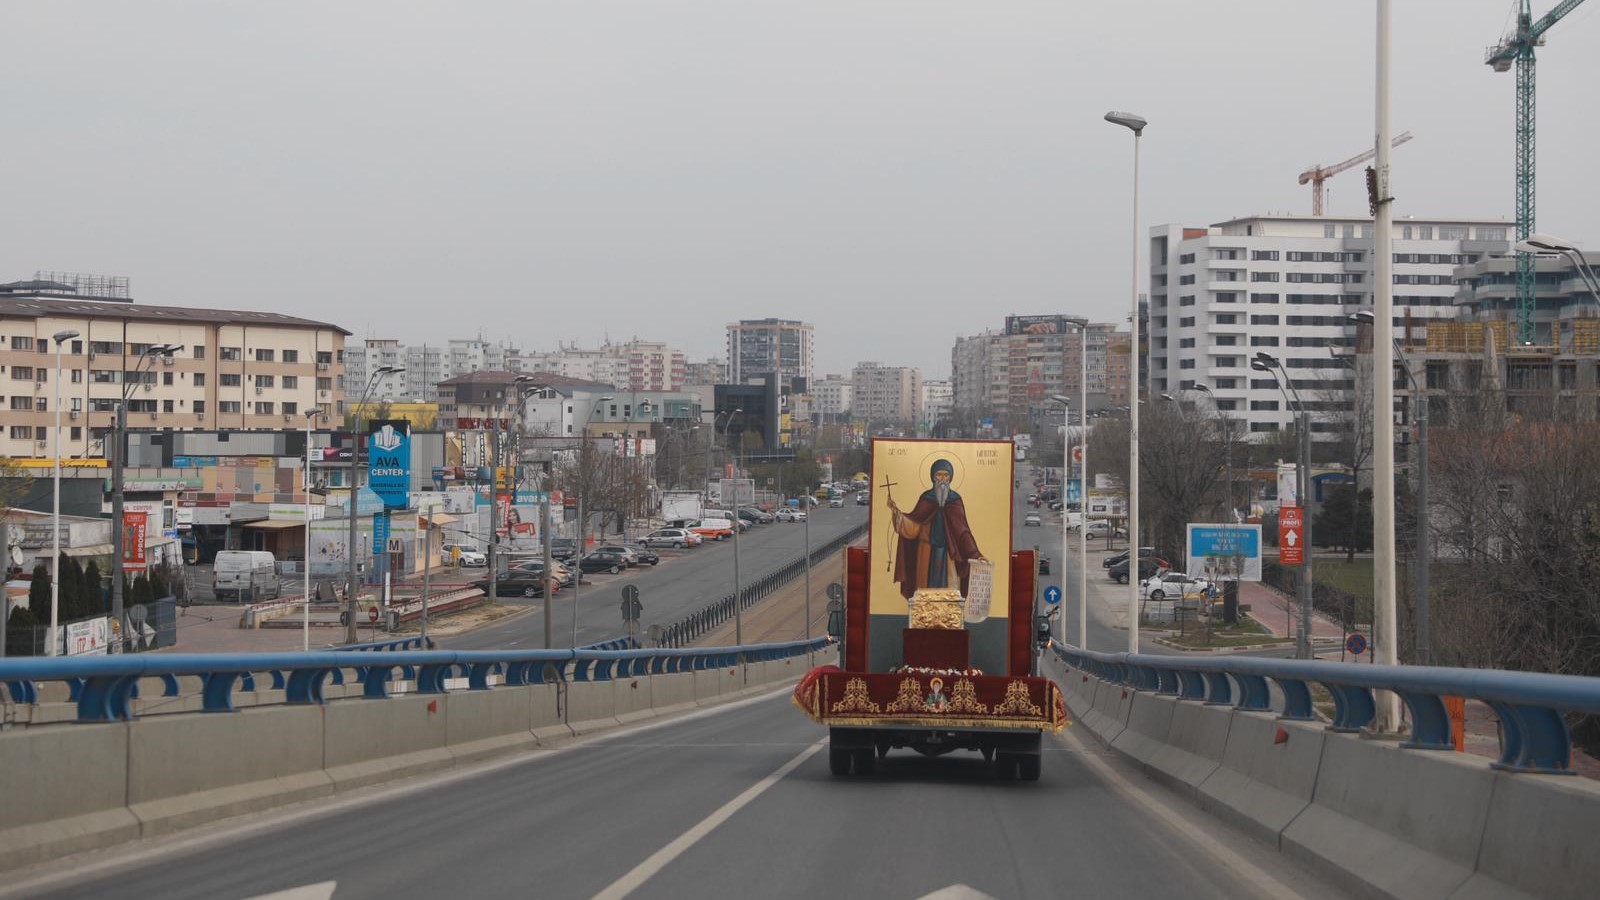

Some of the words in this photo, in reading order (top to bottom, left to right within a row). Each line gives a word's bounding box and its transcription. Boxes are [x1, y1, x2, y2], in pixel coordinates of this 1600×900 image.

[376, 457, 400, 467] AVA
[371, 468, 404, 476] CENTER
[390, 539, 400, 551] M
